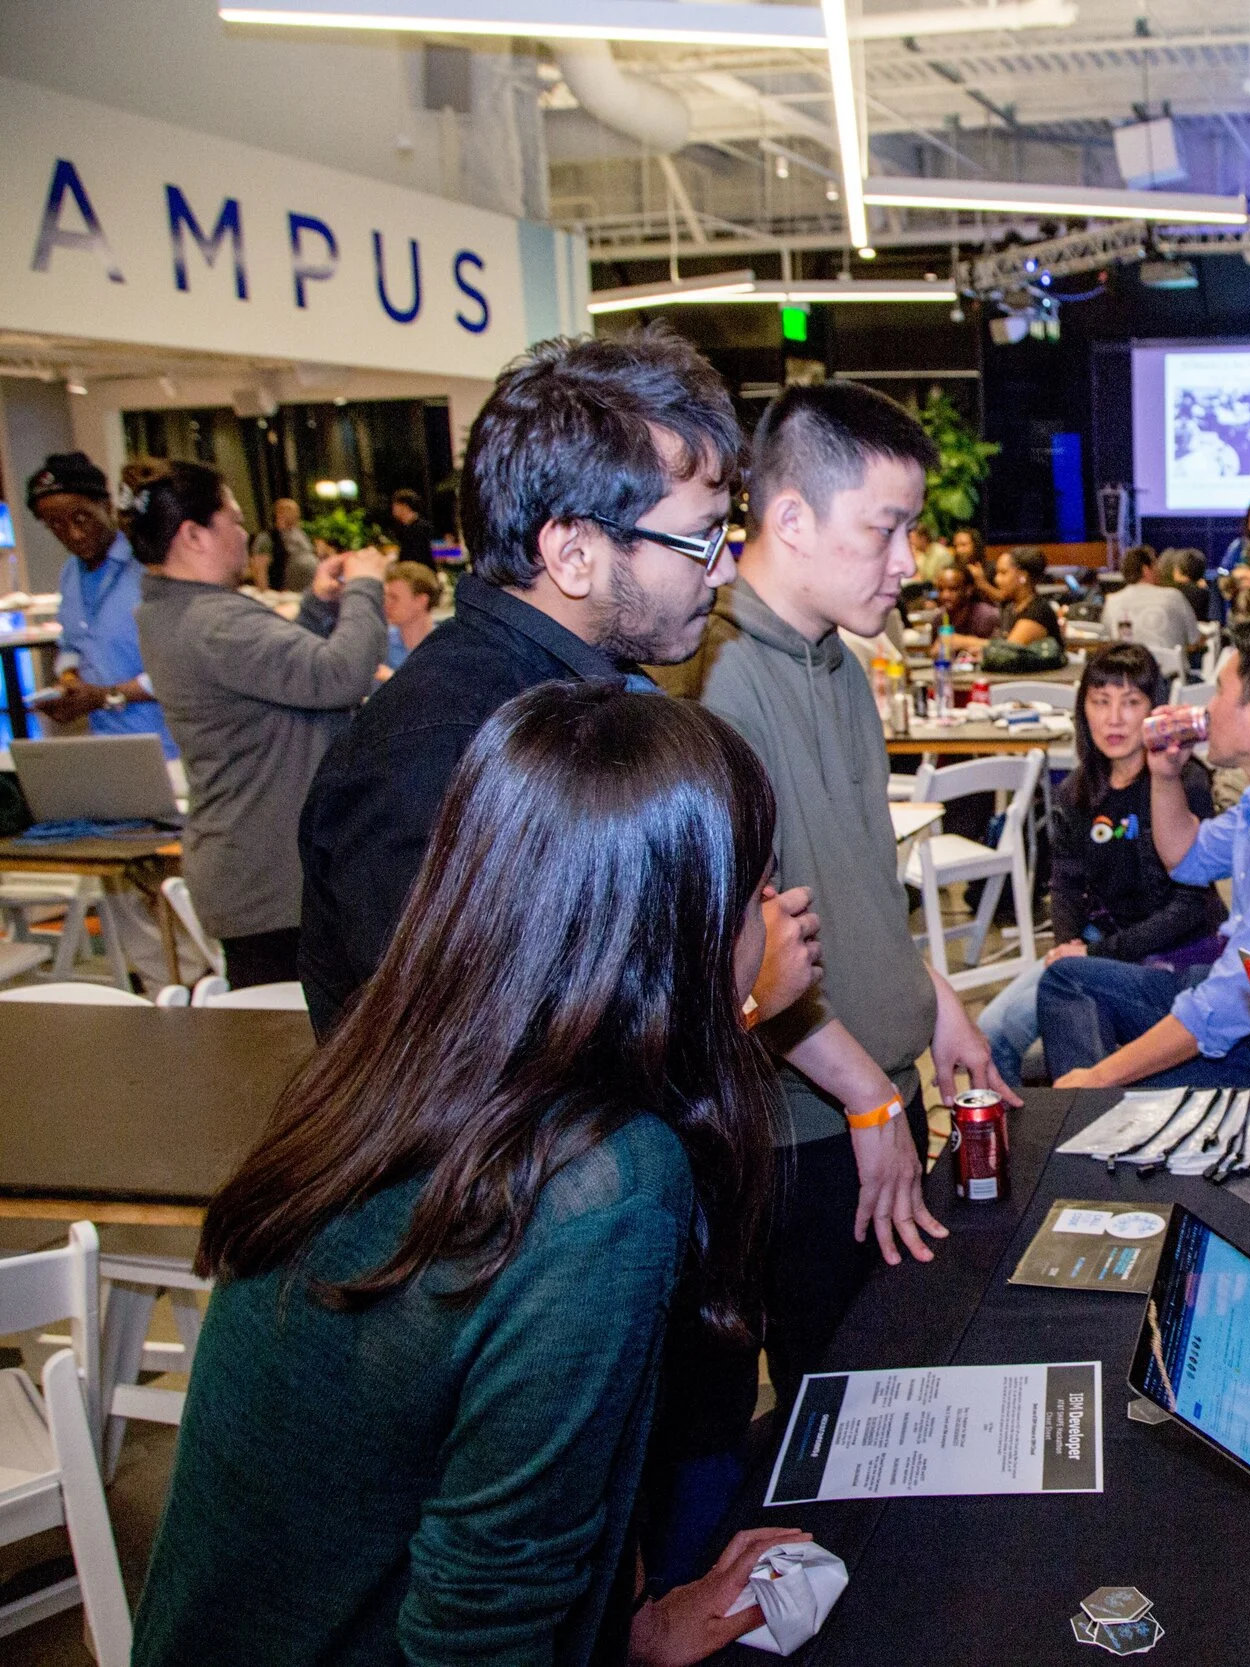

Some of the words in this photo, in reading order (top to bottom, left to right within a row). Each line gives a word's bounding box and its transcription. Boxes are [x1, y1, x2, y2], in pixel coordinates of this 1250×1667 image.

[31, 157, 490, 334] AMPUS
[1069, 1392, 1084, 1410] IBM
[1055, 1428, 1064, 1455] Hackathon
[1065, 1411, 1084, 1460] Developer
